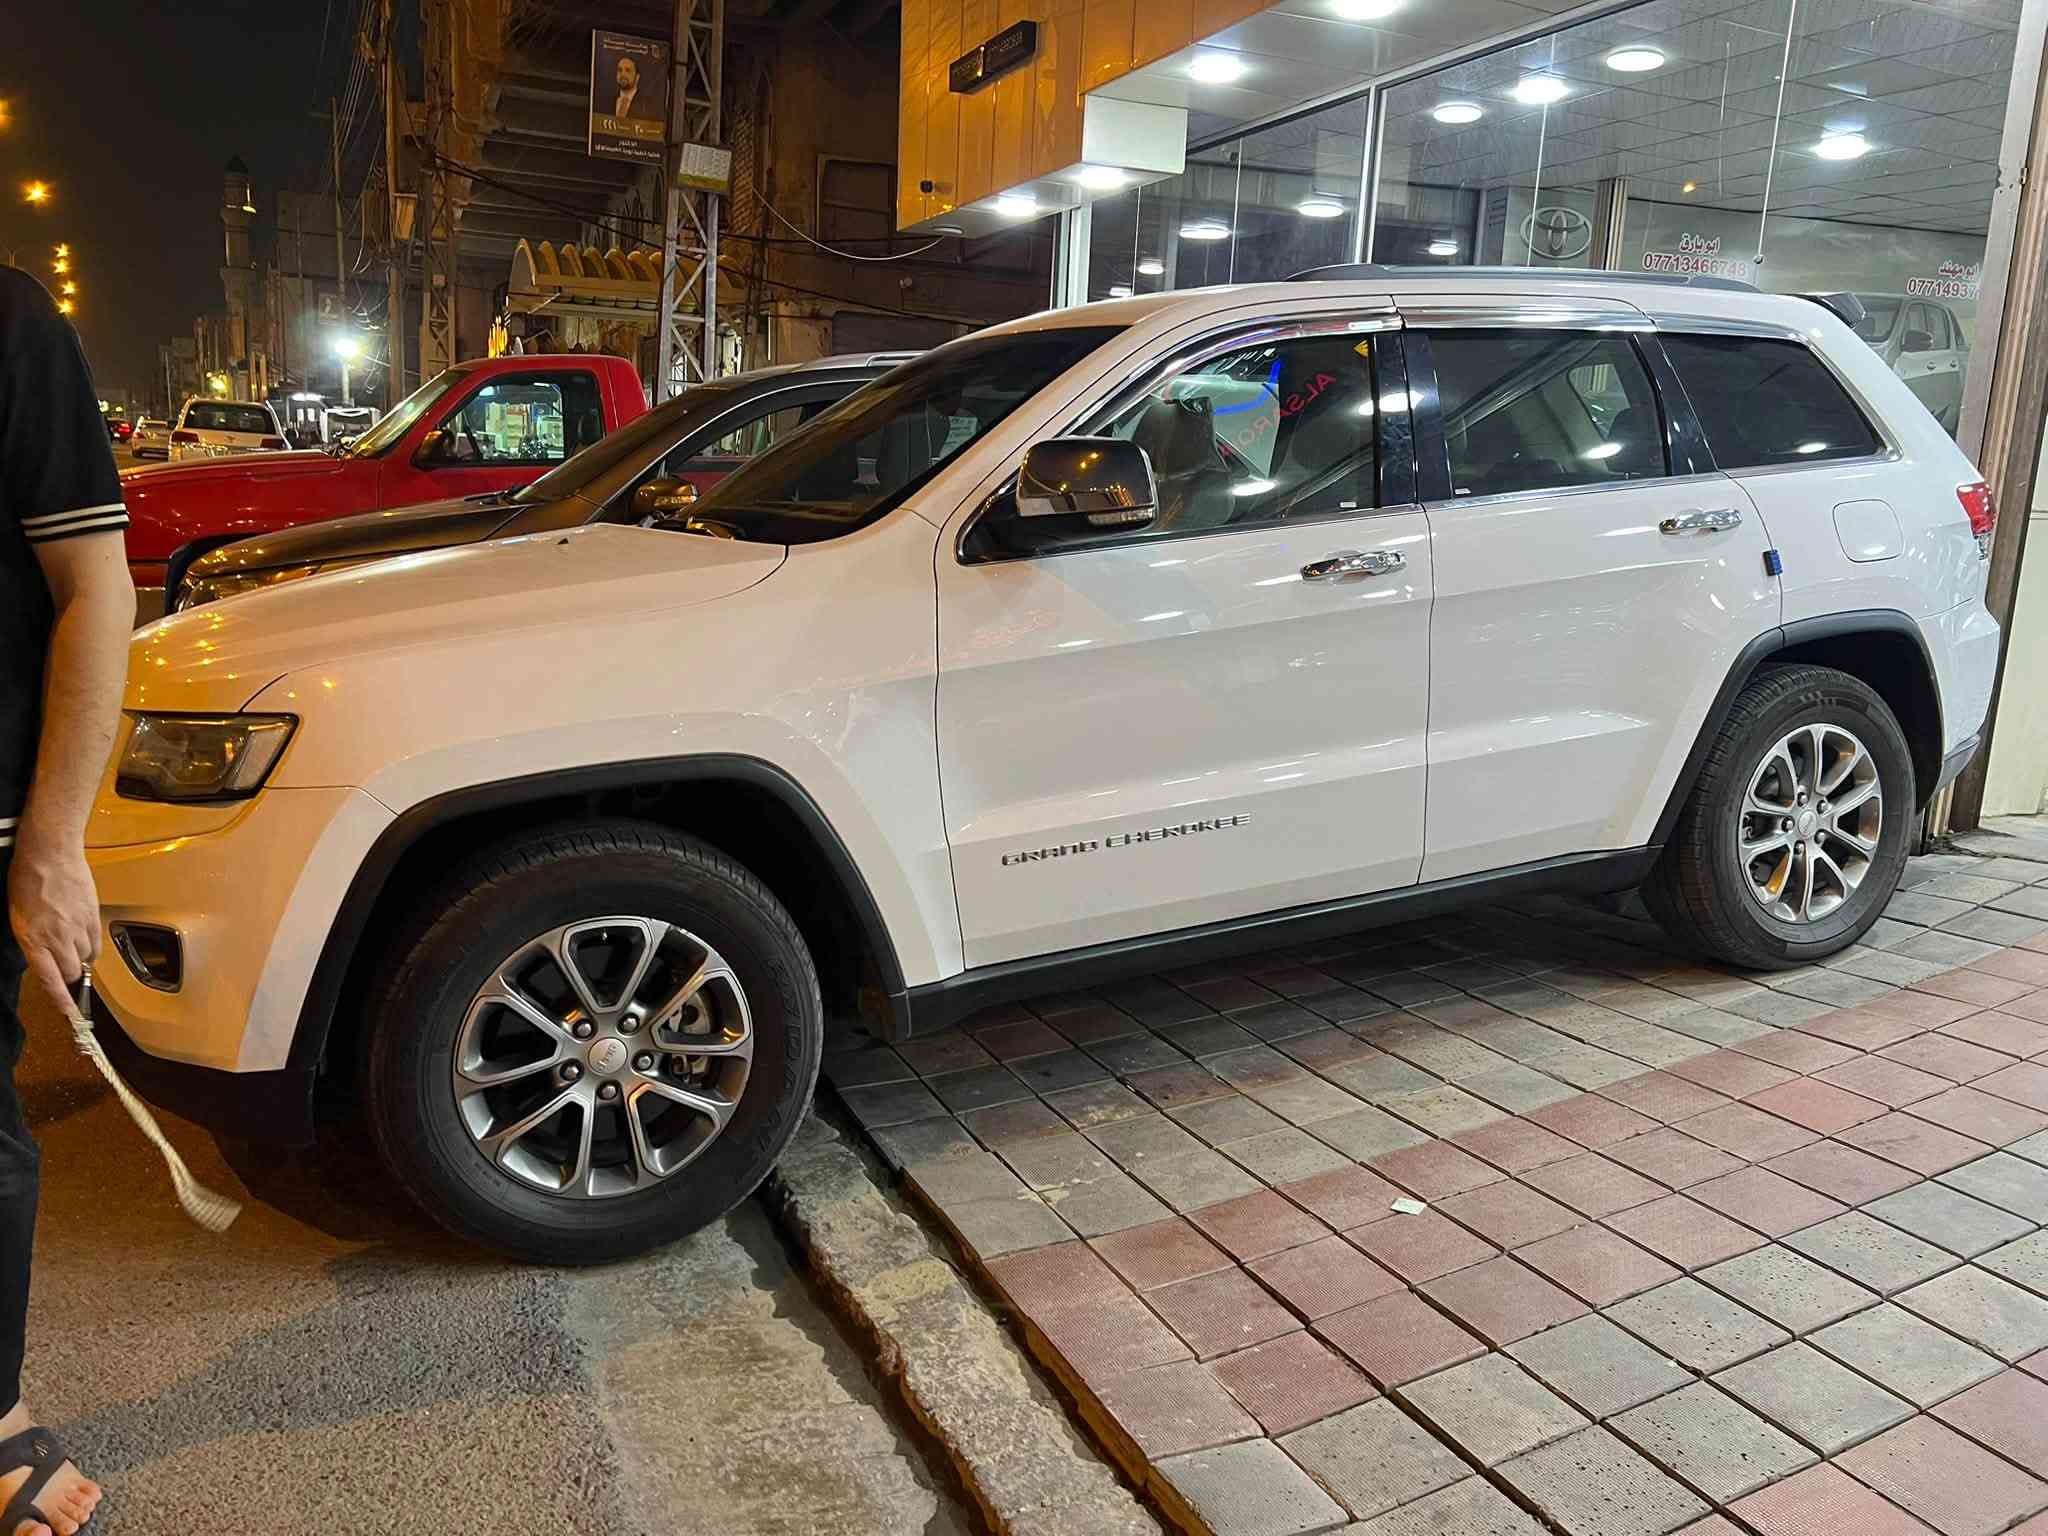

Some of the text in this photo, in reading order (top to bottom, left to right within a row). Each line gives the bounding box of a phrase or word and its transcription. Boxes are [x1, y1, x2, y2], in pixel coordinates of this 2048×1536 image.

[1642, 251, 1746, 277] 07713466748
[1001, 813, 1252, 866] GRAND CHEROKEE
